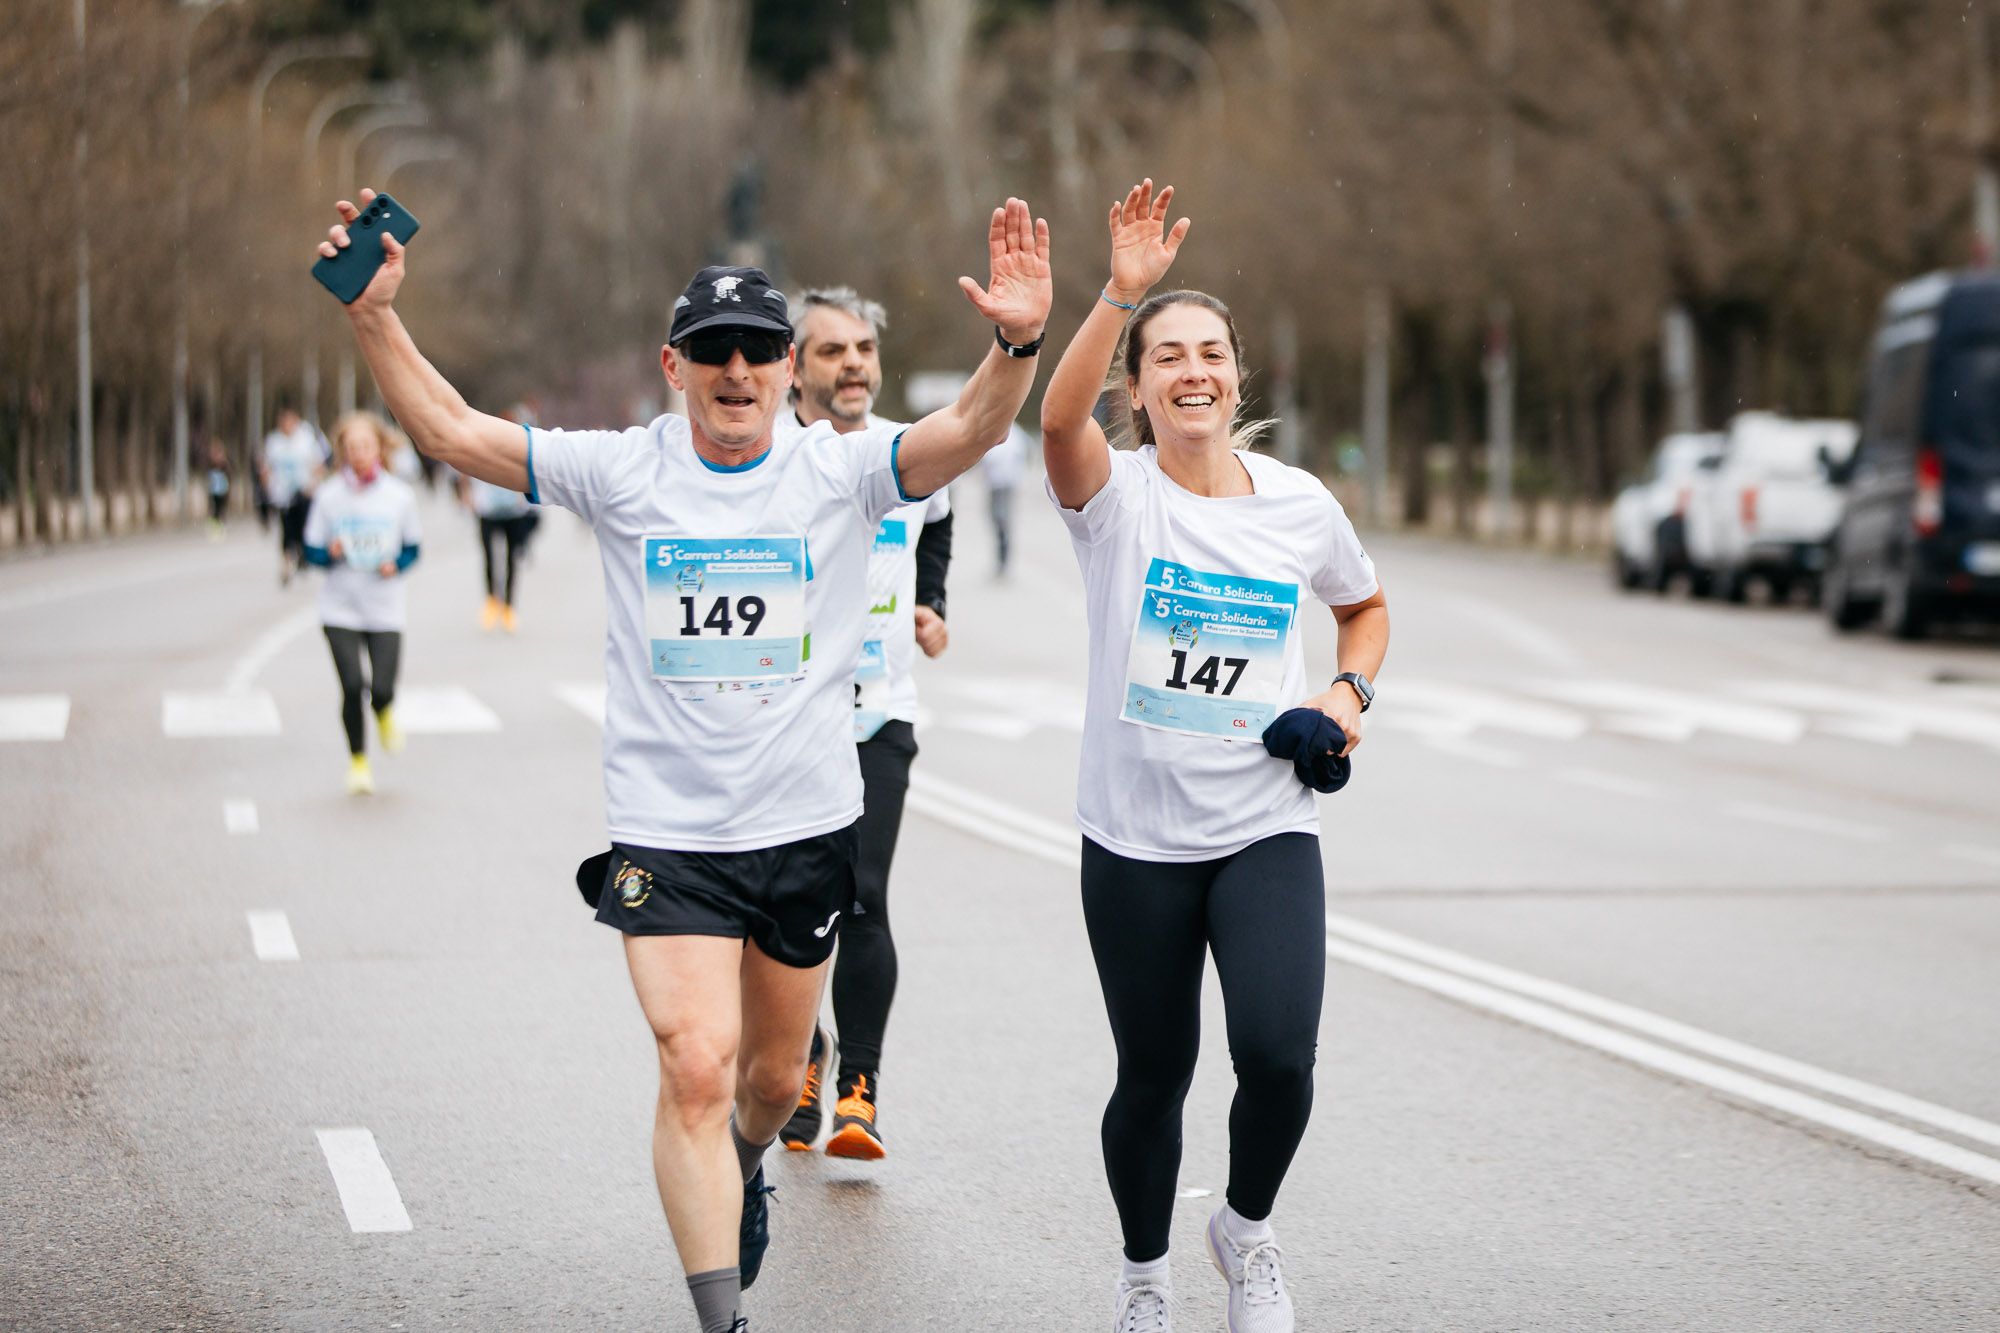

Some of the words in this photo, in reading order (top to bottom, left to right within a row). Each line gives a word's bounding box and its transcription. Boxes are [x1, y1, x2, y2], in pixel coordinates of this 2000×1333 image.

[674, 549, 721, 560] Carrera
[724, 548, 778, 560] Solidaria
[1179, 576, 1221, 595] Carrera
[1224, 585, 1274, 602] Solidaria
[680, 596, 766, 636] 149
[1173, 605, 1219, 621] Carrera
[1221, 611, 1268, 627] Solidaria
[1166, 649, 1249, 696] 147
[1233, 718, 1248, 729] CSL
